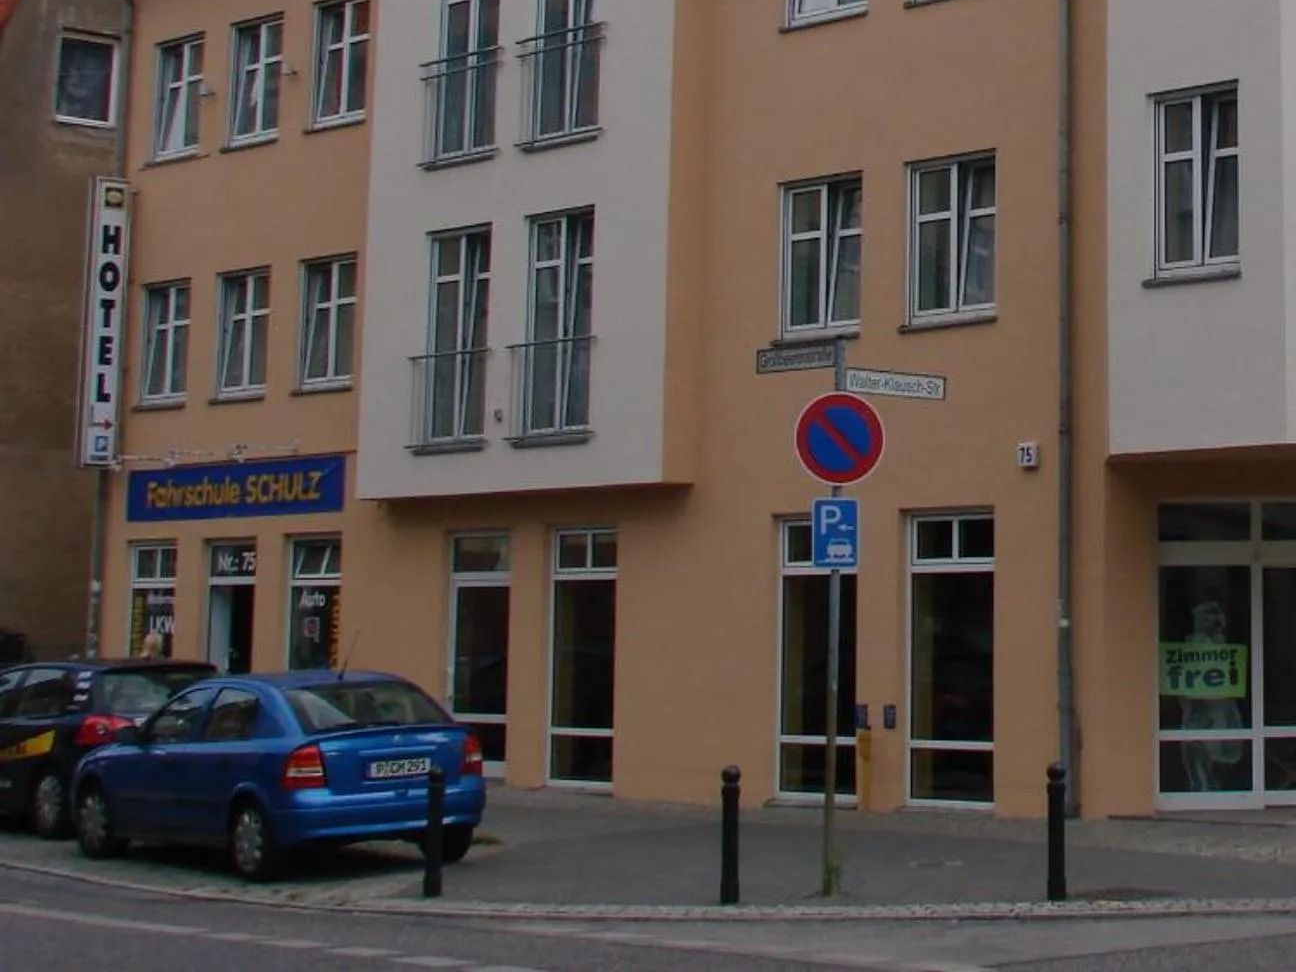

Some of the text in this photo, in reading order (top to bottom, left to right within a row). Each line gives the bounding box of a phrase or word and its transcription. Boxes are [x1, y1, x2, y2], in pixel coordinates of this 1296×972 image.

[95, 225, 121, 403] HOTEL
[1018, 446, 1033, 463] 75
[147, 471, 322, 509] Fahrschule SCHULZ
[820, 505, 841, 535] P
[299, 589, 326, 607] Auto
[1165, 648, 1238, 664] Zimmer
[1167, 661, 1238, 690] frei
